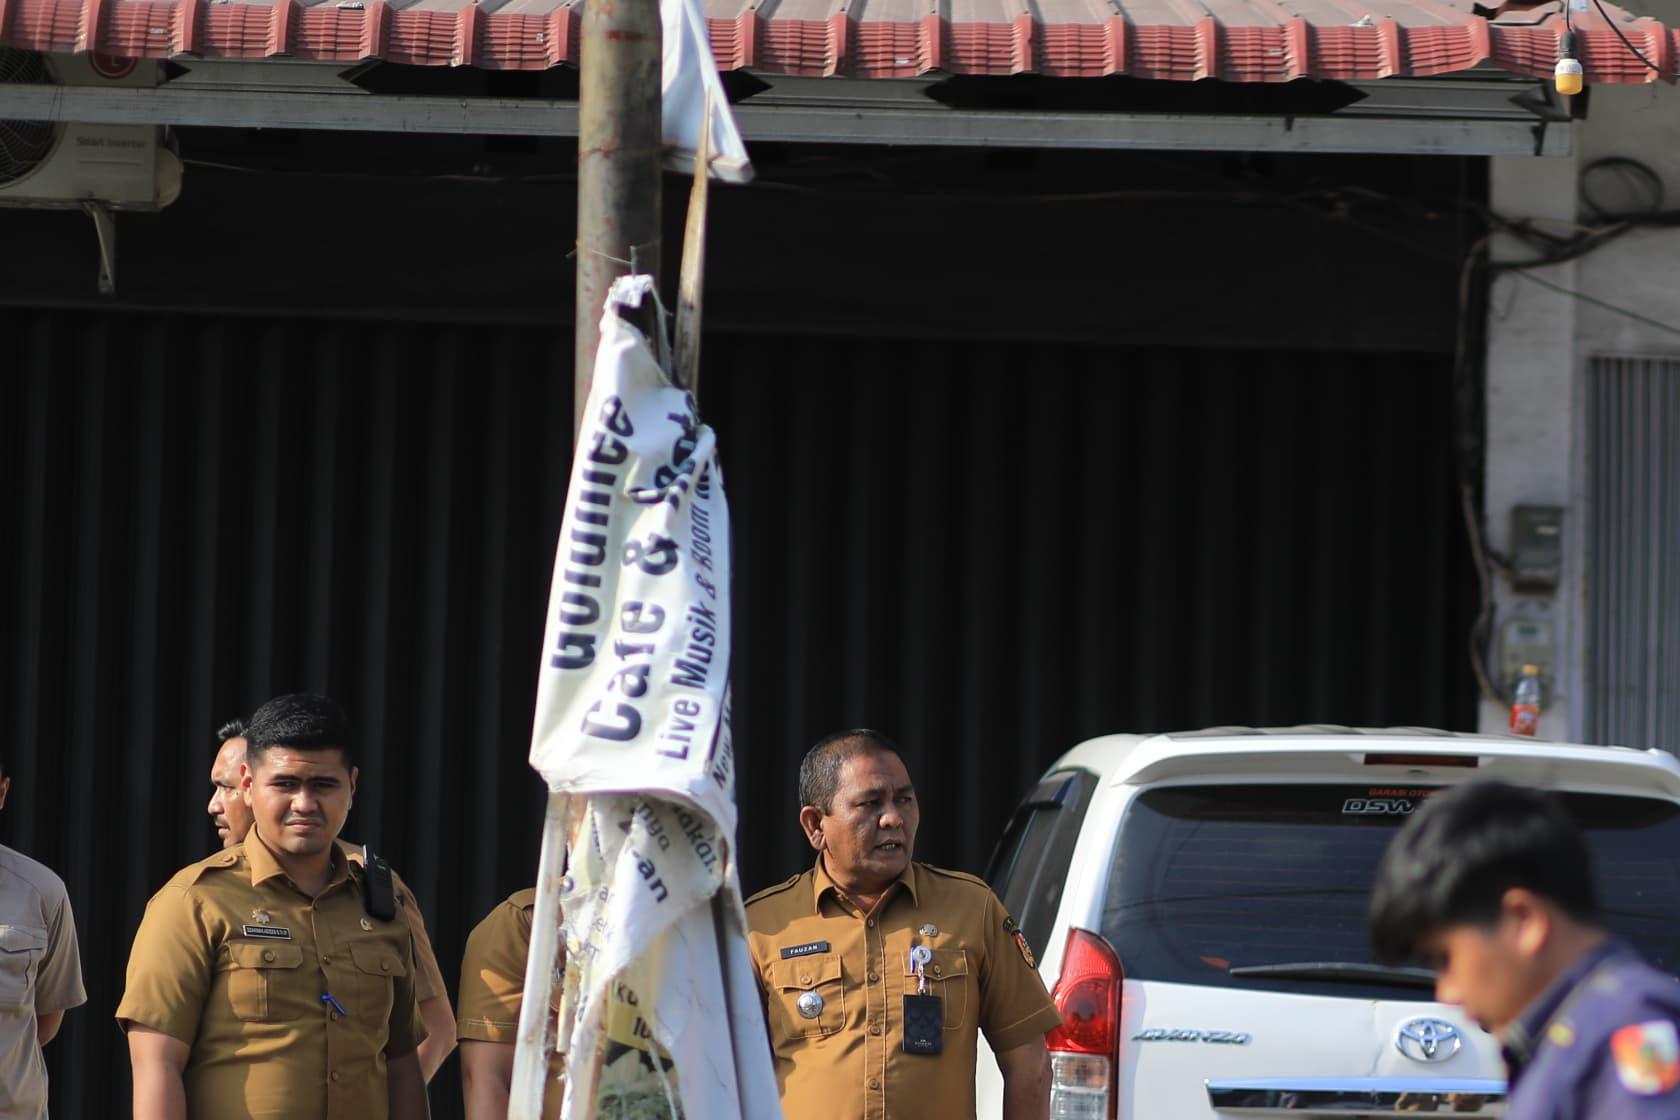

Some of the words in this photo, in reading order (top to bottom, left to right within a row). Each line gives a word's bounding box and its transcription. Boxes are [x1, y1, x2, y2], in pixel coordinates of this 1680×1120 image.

[580, 599, 667, 744] Cafe
[669, 608, 718, 692] Musik
[656, 698, 701, 762] Live
[790, 945, 818, 955] FAUZAN
